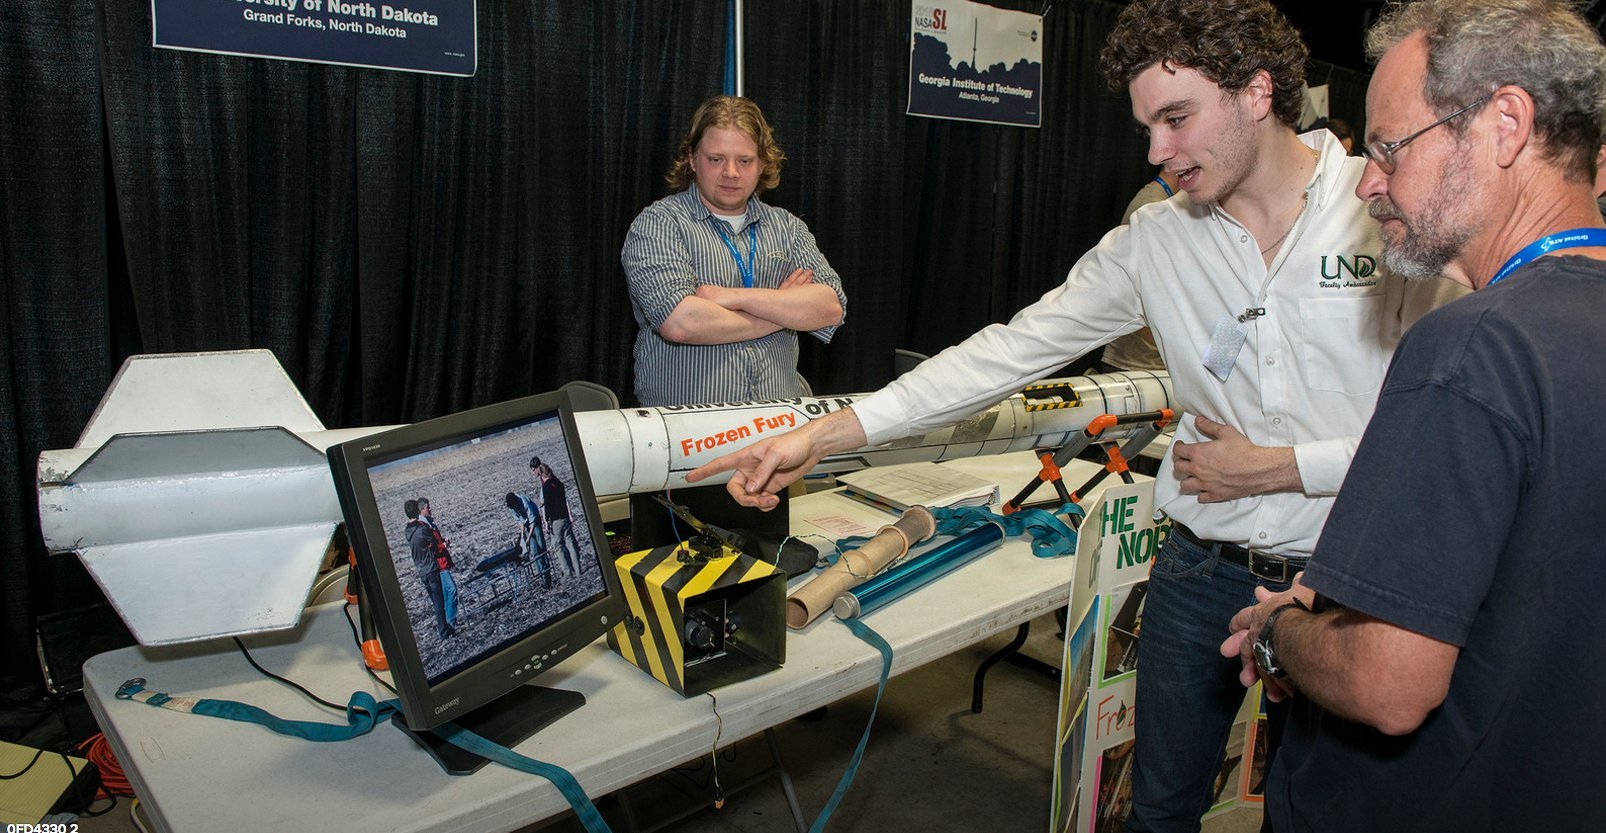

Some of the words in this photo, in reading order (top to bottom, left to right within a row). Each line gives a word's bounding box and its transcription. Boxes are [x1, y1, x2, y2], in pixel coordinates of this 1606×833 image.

[243, 9, 283, 24] Grand
[287, 14, 326, 31] Forks,
[329, 19, 363, 33] North
[366, 23, 407, 38] Dakota
[303, 0, 322, 11] of
[327, 0, 376, 18] North
[381, 5, 438, 26] Dakota
[933, 8, 947, 30] SL
[919, 73, 950, 87] Georgia
[952, 78, 985, 91] Institute
[987, 83, 995, 92] of
[995, 83, 1033, 98] Technology
[958, 91, 980, 101] Atlanta,
[980, 94, 1000, 104] Georgia
[1321, 255, 1376, 279] UND
[805, 402, 830, 416] of
[680, 425, 751, 457] Frozen
[753, 412, 797, 433] Fury
[434, 697, 460, 715] Gateway
